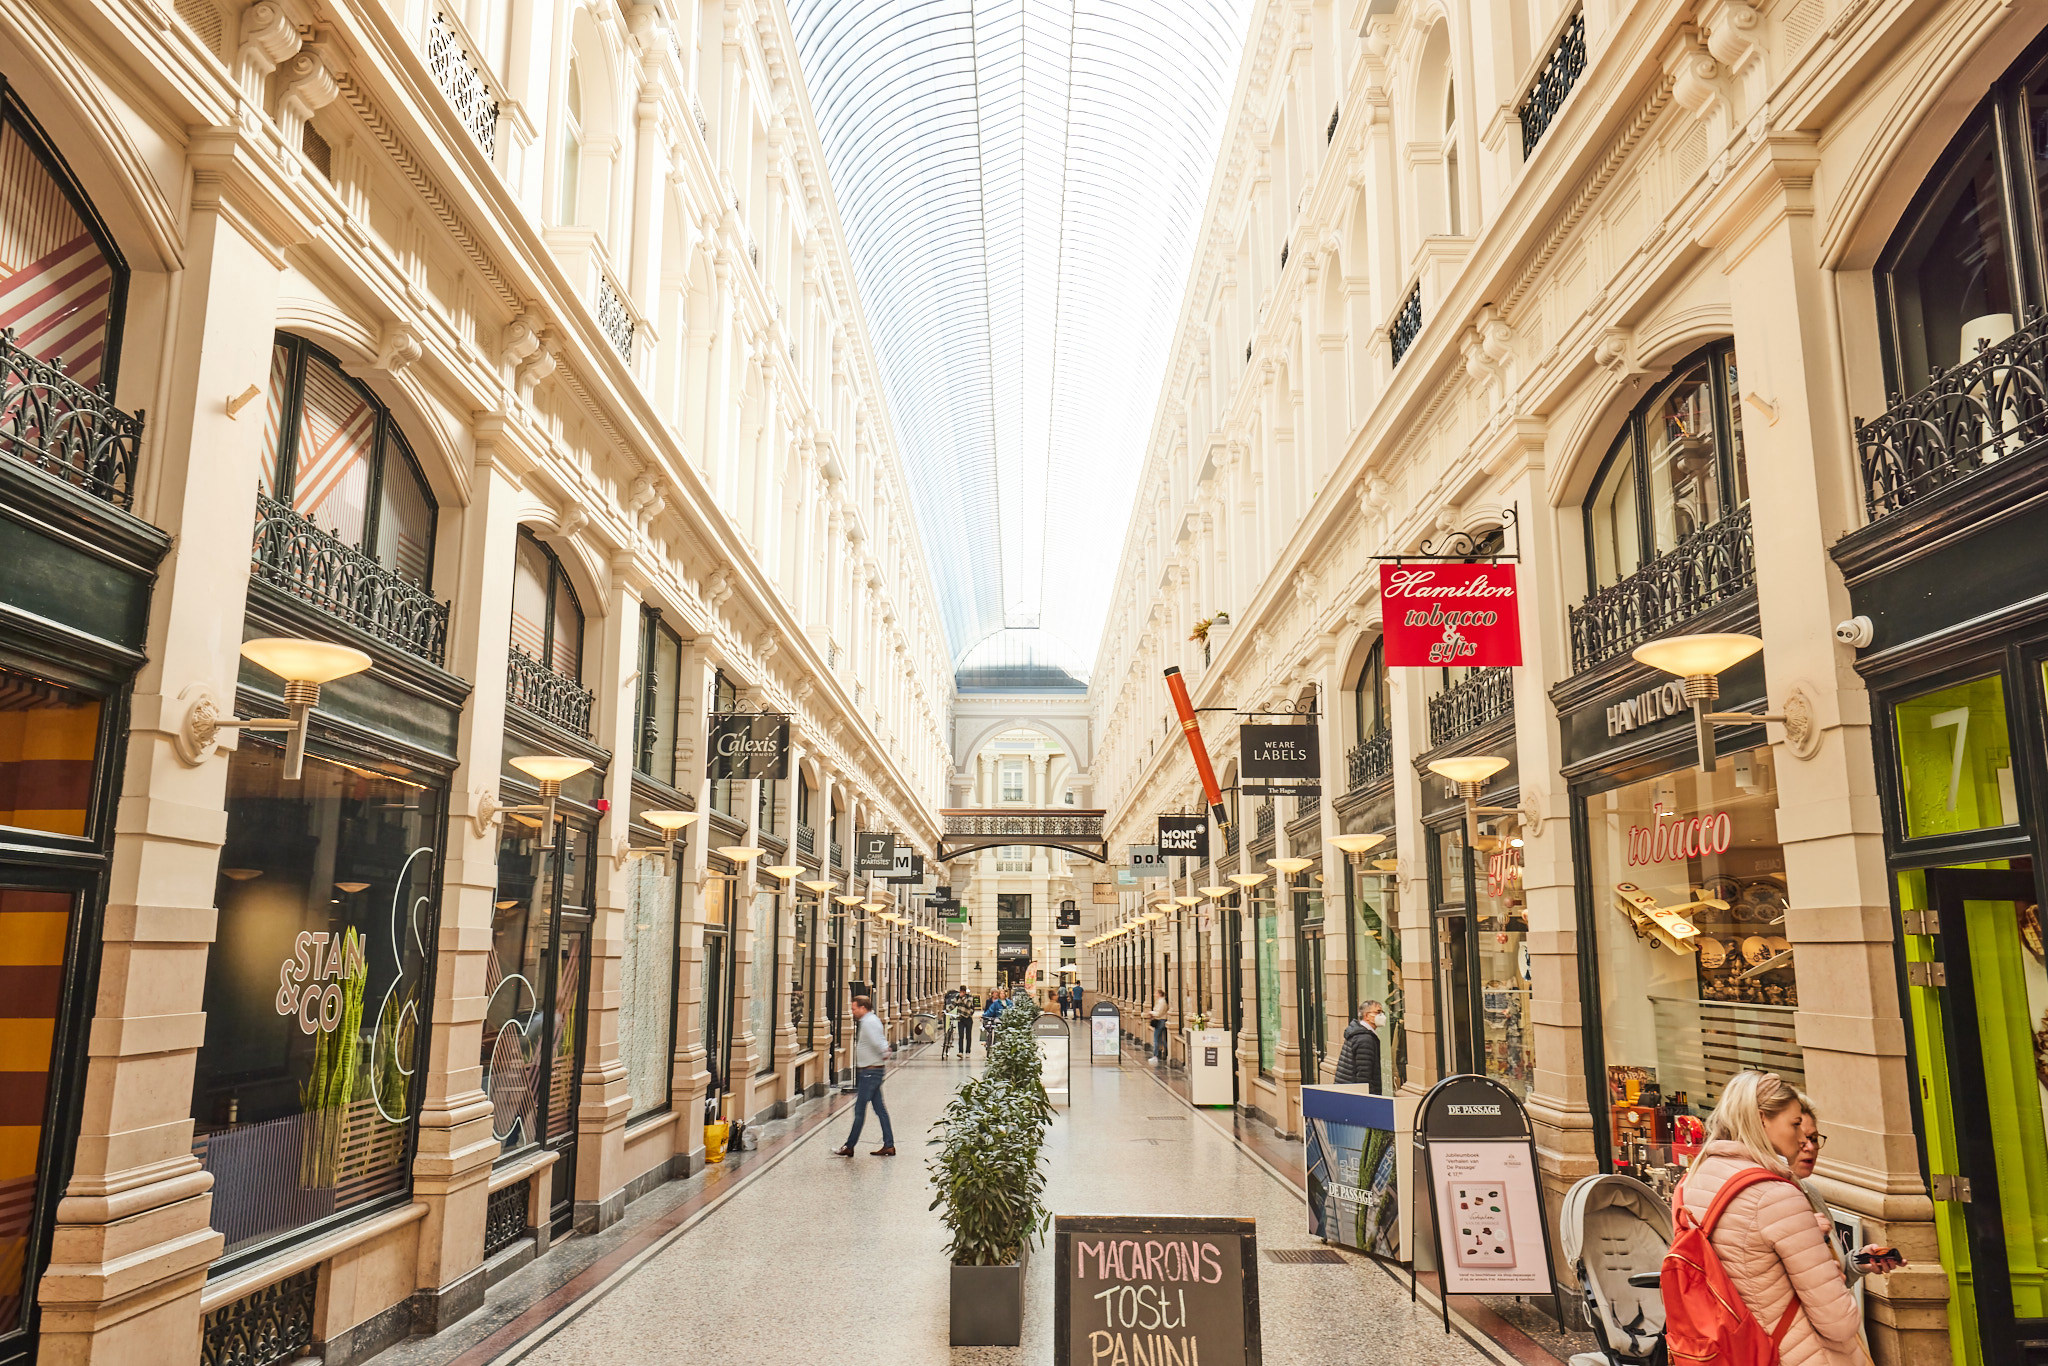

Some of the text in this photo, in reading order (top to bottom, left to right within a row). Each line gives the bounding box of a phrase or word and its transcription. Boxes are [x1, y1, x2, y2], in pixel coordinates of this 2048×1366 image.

[1384, 570, 1515, 598] Hamilton
[1404, 603, 1498, 626] tobacco
[1442, 624, 1464, 644] &
[1428, 635, 1478, 663] gifts
[1606, 679, 1694, 737] HAMILTON
[717, 732, 777, 757] Calexis
[1254, 749, 1307, 761] LABELS
[1930, 706, 1970, 812] 7
[1161, 829, 1197, 840] MONT
[1161, 839, 1197, 849] BLANC
[1628, 803, 1732, 867] tobacco
[1132, 855, 1165, 864] DOK
[1488, 835, 1521, 898] gifts
[293, 931, 367, 982] STAN
[1448, 1105, 1501, 1115] DE PASSAGE
[1328, 1184, 1373, 1205] DE PASSAGE
[1077, 1240, 1223, 1284] MACARONS
[1089, 1330, 1199, 1366] PANINI
